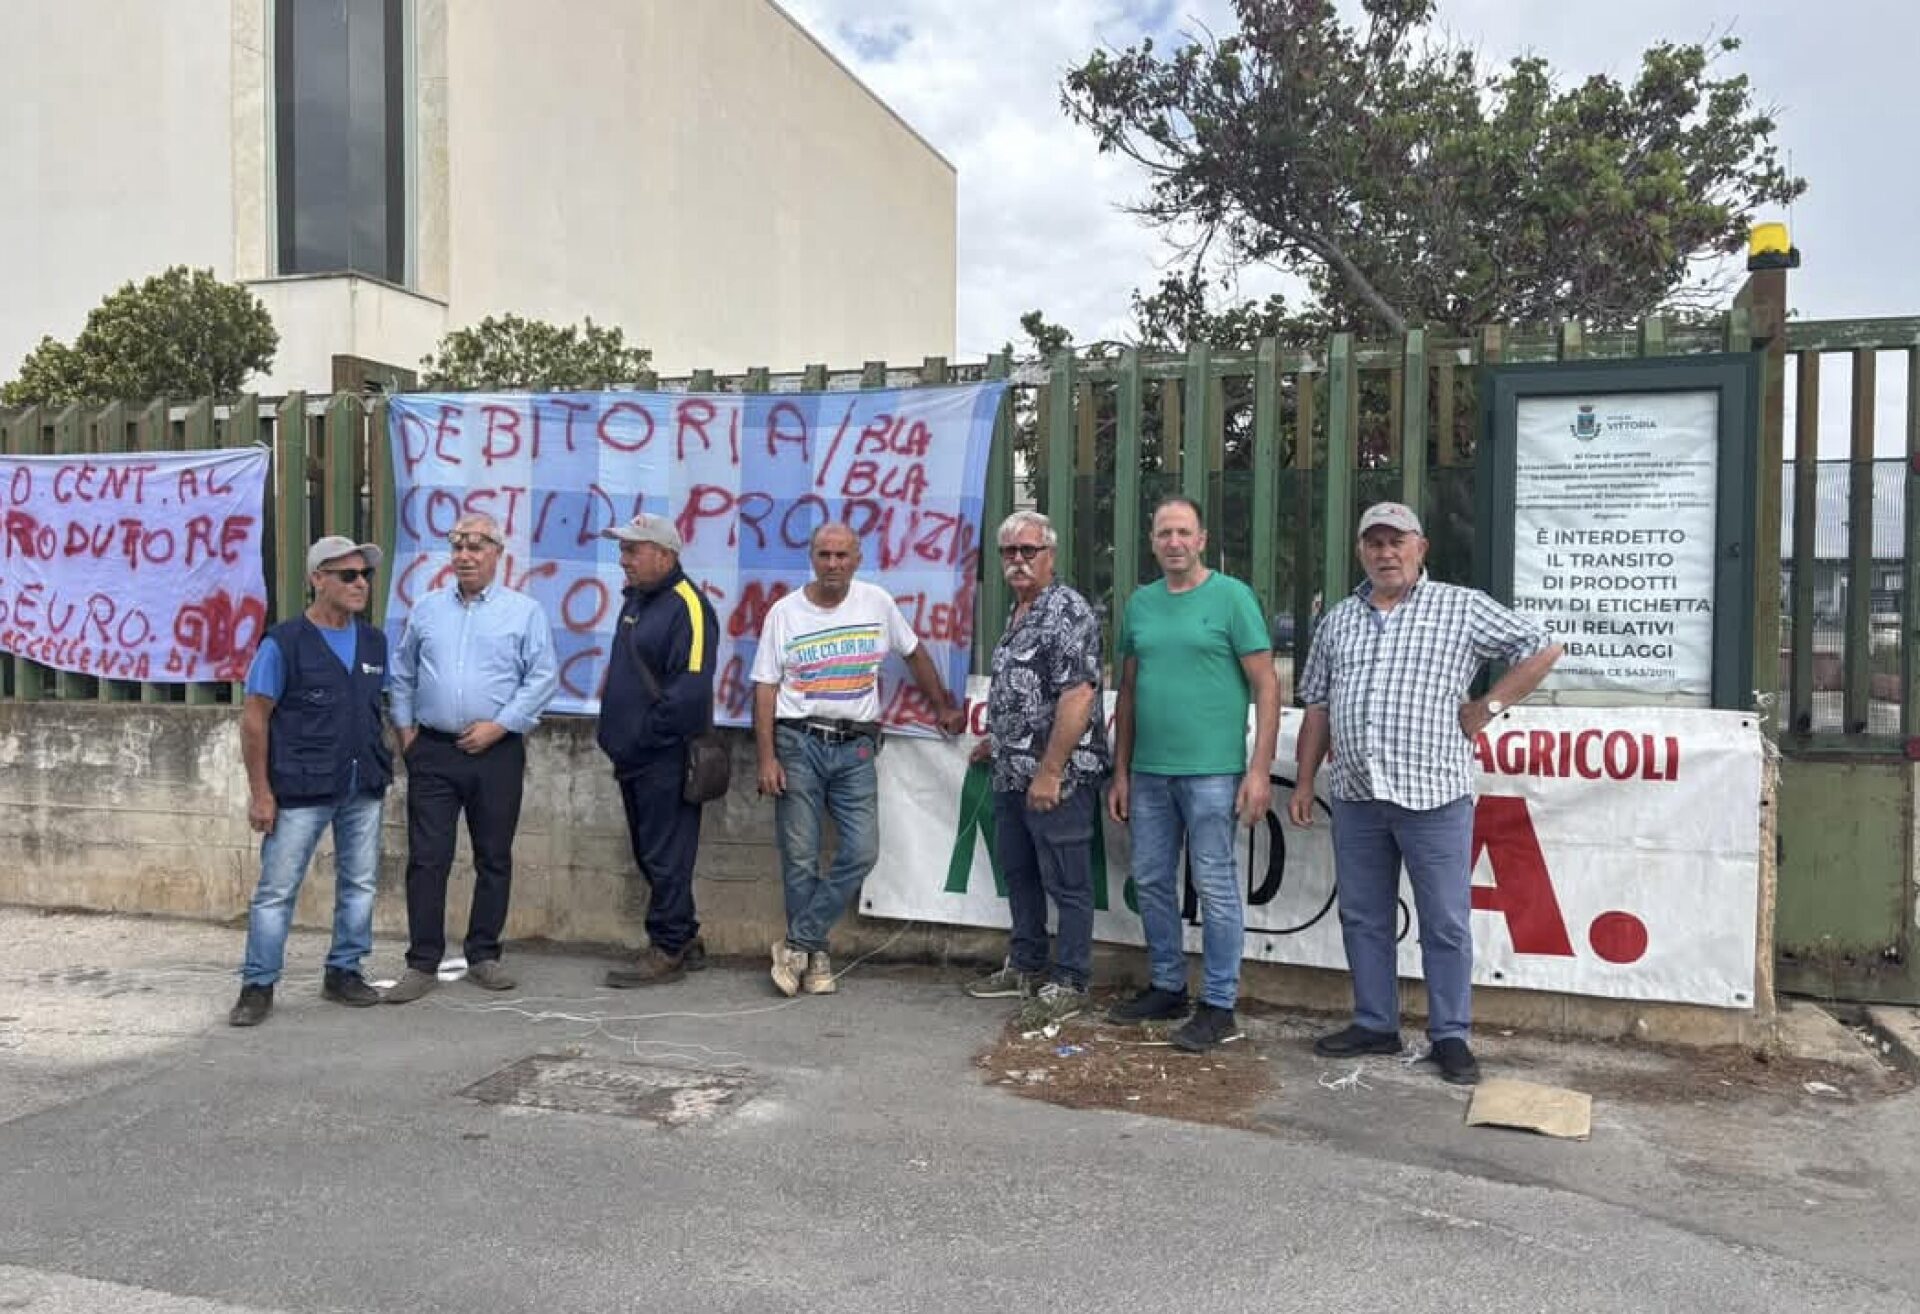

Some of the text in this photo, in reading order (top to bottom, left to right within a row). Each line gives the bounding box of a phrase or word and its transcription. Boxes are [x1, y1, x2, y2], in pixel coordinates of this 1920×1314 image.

[402, 399, 809, 478] DEBITORIA
[855, 414, 934, 456] BLA
[841, 461, 930, 506] BLA
[0, 510, 255, 570] RODUTORE
[1536, 527, 1686, 545] È INTERDETTO
[1547, 552, 1674, 568] IL TRANSITO
[1543, 575, 1677, 590] DI PRODOTTI
[1512, 598, 1711, 613] PRIVI DI ETICHETTA
[1544, 619, 1674, 635] SUI RELATIVI
[1563, 642, 1673, 659] BALLAGGI
[1471, 728, 1680, 783] AGRICOLI
